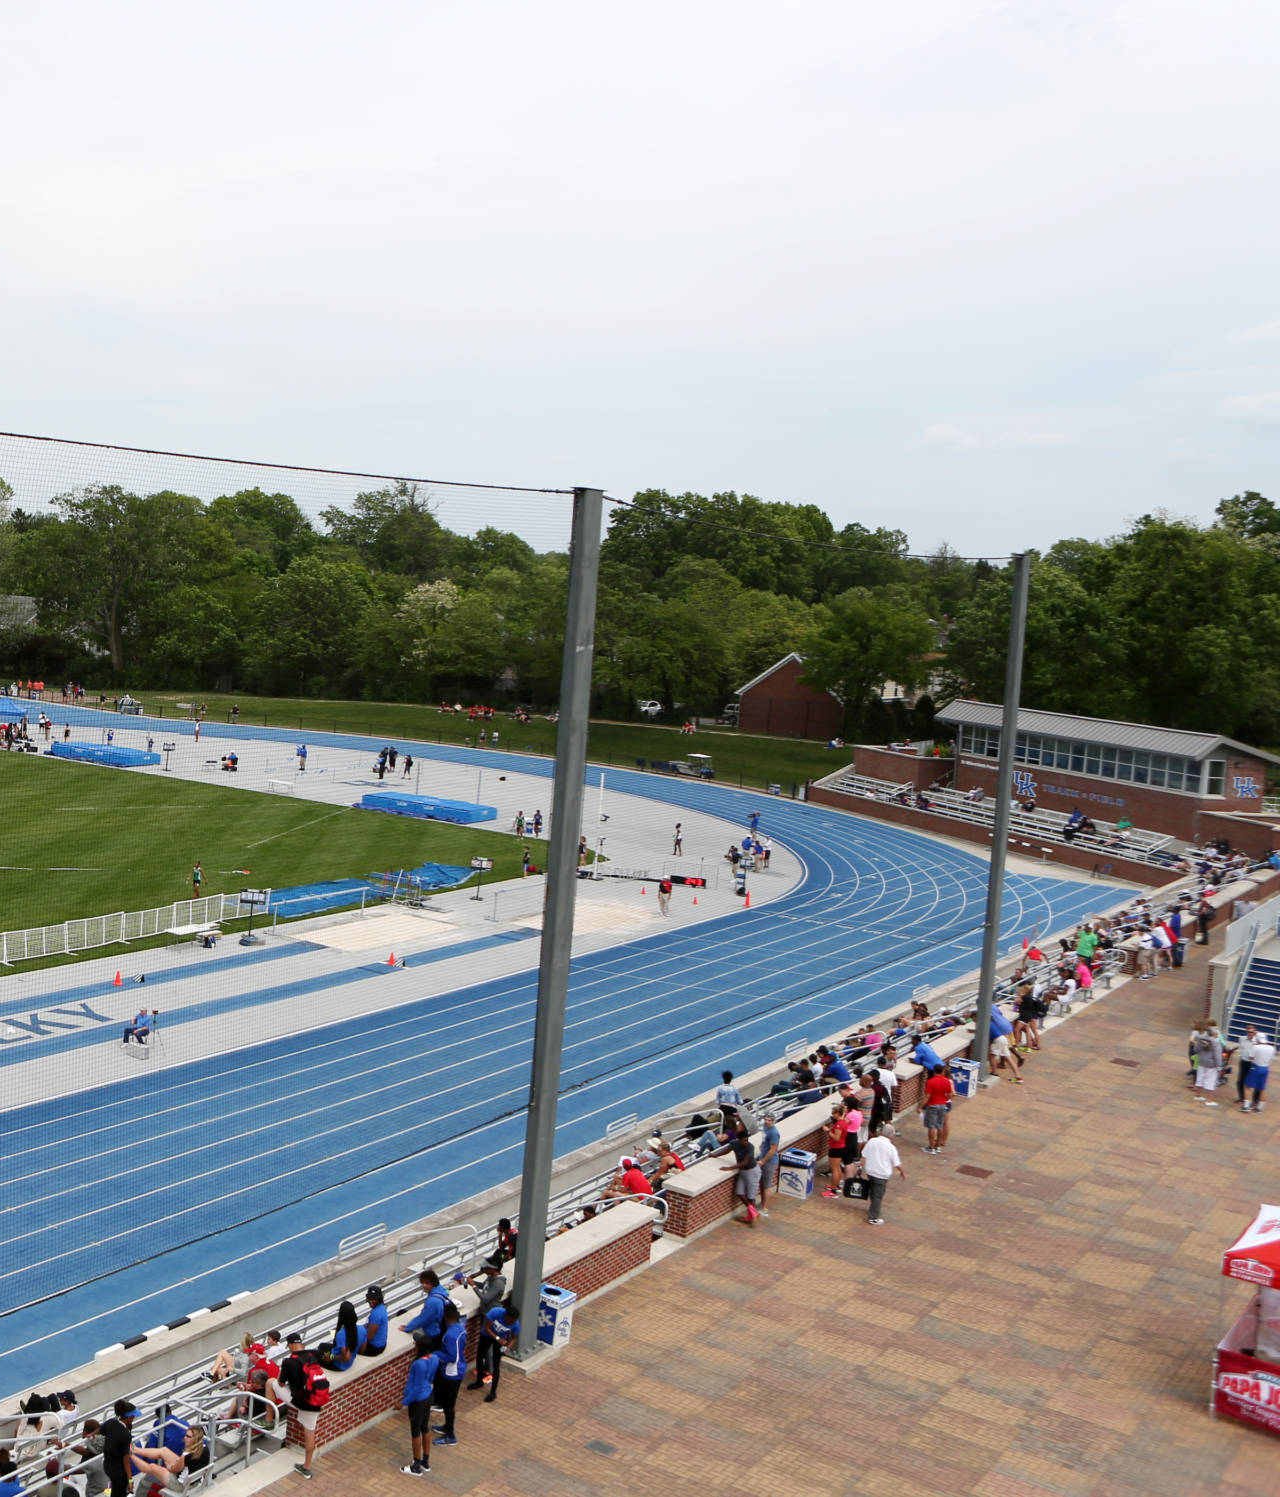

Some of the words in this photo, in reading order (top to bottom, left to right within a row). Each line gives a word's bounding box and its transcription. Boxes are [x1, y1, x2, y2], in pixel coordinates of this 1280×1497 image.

[1013, 771, 1038, 798] UK
[1232, 776, 1261, 799] UK
[1222, 1376, 1261, 1402] PAPA
